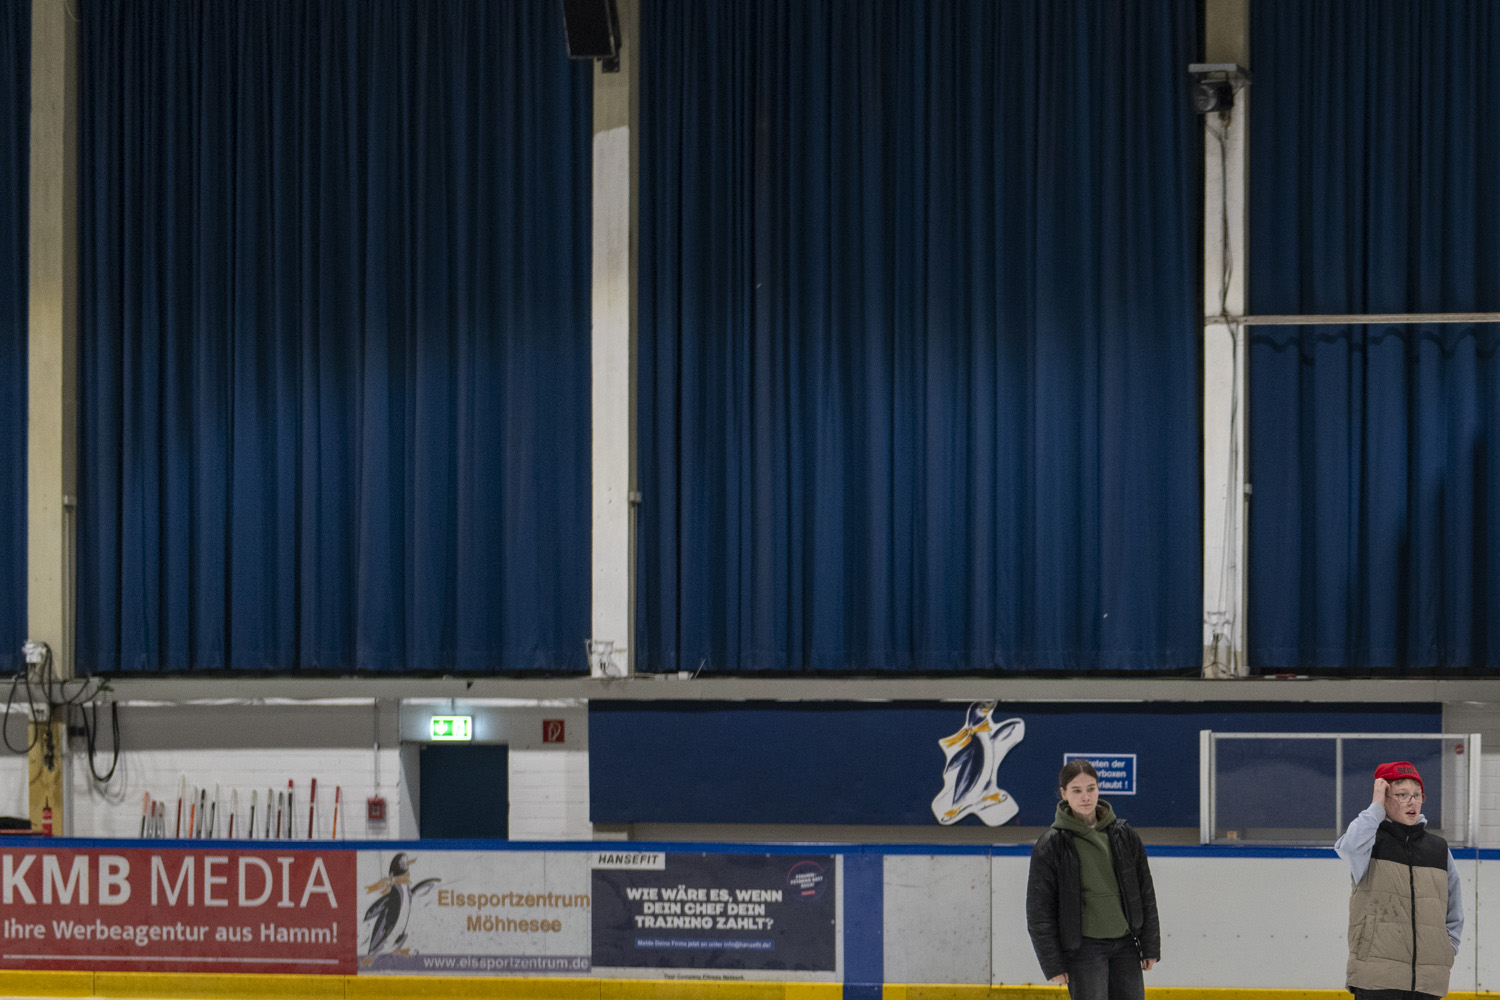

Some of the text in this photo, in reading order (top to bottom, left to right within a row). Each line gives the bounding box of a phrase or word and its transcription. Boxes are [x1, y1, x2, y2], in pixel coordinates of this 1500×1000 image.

[1088, 760, 1125, 769] reten der
[1098, 769, 1126, 778] rboxen
[1098, 780, 1122, 789] rlaubt
[598, 853, 659, 865] HANSEFIT
[2, 853, 338, 909] KMB MEDIA
[437, 889, 591, 910] Eissportzentrum
[626, 885, 782, 903] WIE WÄRE ES, WENN
[643, 902, 765, 916] DEIN CHEF DEIN
[466, 914, 562, 933] Möhnesee
[635, 915, 774, 930] TRAINING ZAHLT?
[4, 919, 338, 947] Ihre Werbeagentur aus Hamm!
[423, 955, 589, 974] www.eissportzentrum.de
